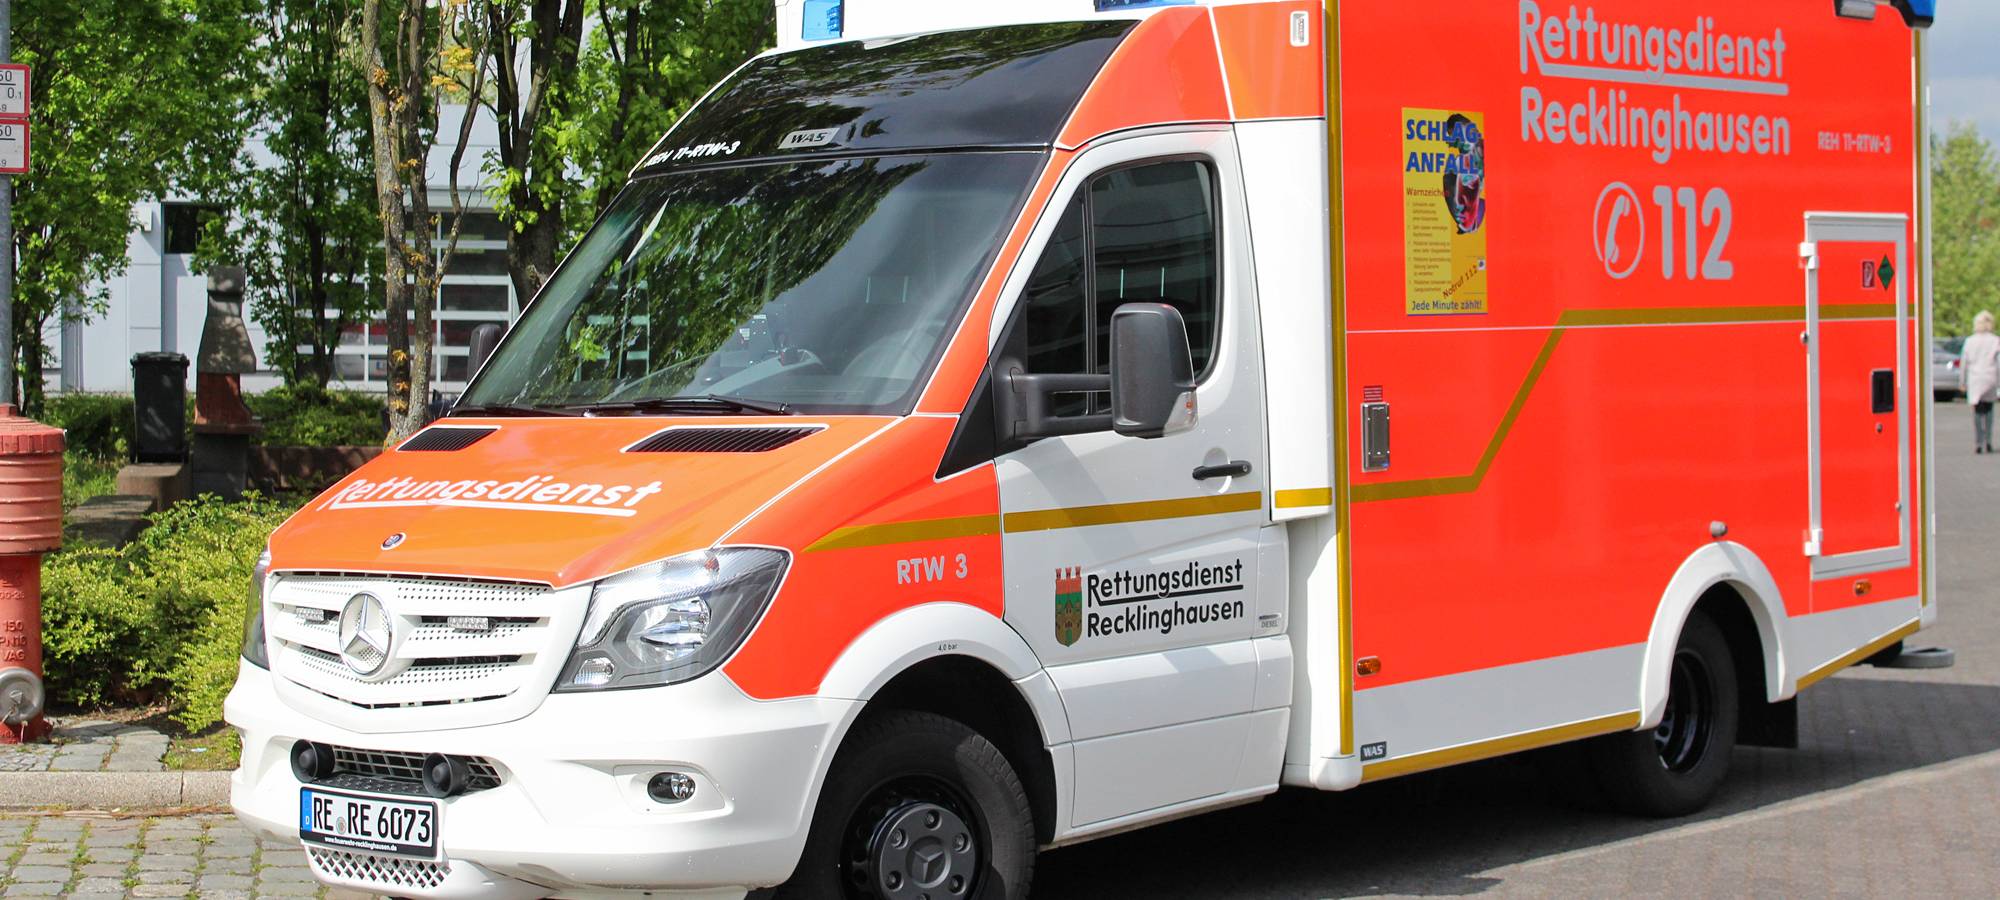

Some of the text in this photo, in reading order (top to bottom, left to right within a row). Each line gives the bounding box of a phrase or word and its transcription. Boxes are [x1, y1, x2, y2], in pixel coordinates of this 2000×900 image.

[1518, 0, 1787, 79] Rettungsdienst
[1406, 119, 1482, 143] SCHLAG-
[1520, 86, 1790, 164] Recklinghausen
[790, 132, 827, 144] WAS
[1818, 131, 1891, 154] REH 11-RTW-3
[673, 141, 741, 161] 11-RTW-3
[1406, 151, 1479, 174] ANFALL
[1653, 185, 1733, 280] 112
[1443, 275, 1464, 299] Notruf
[1412, 300, 1482, 310] Jede Minute zählt!
[316, 475, 662, 511] Rettungsdienst
[896, 554, 968, 584] RTW 3
[1087, 558, 1243, 607] Rettungsdienst
[4, 620, 24, 631] 150
[1087, 600, 1244, 638] Recklinghausen
[1363, 744, 1384, 757] WAS
[313, 797, 334, 831] RE
[347, 802, 372, 836] RE
[377, 806, 431, 842] 6073
